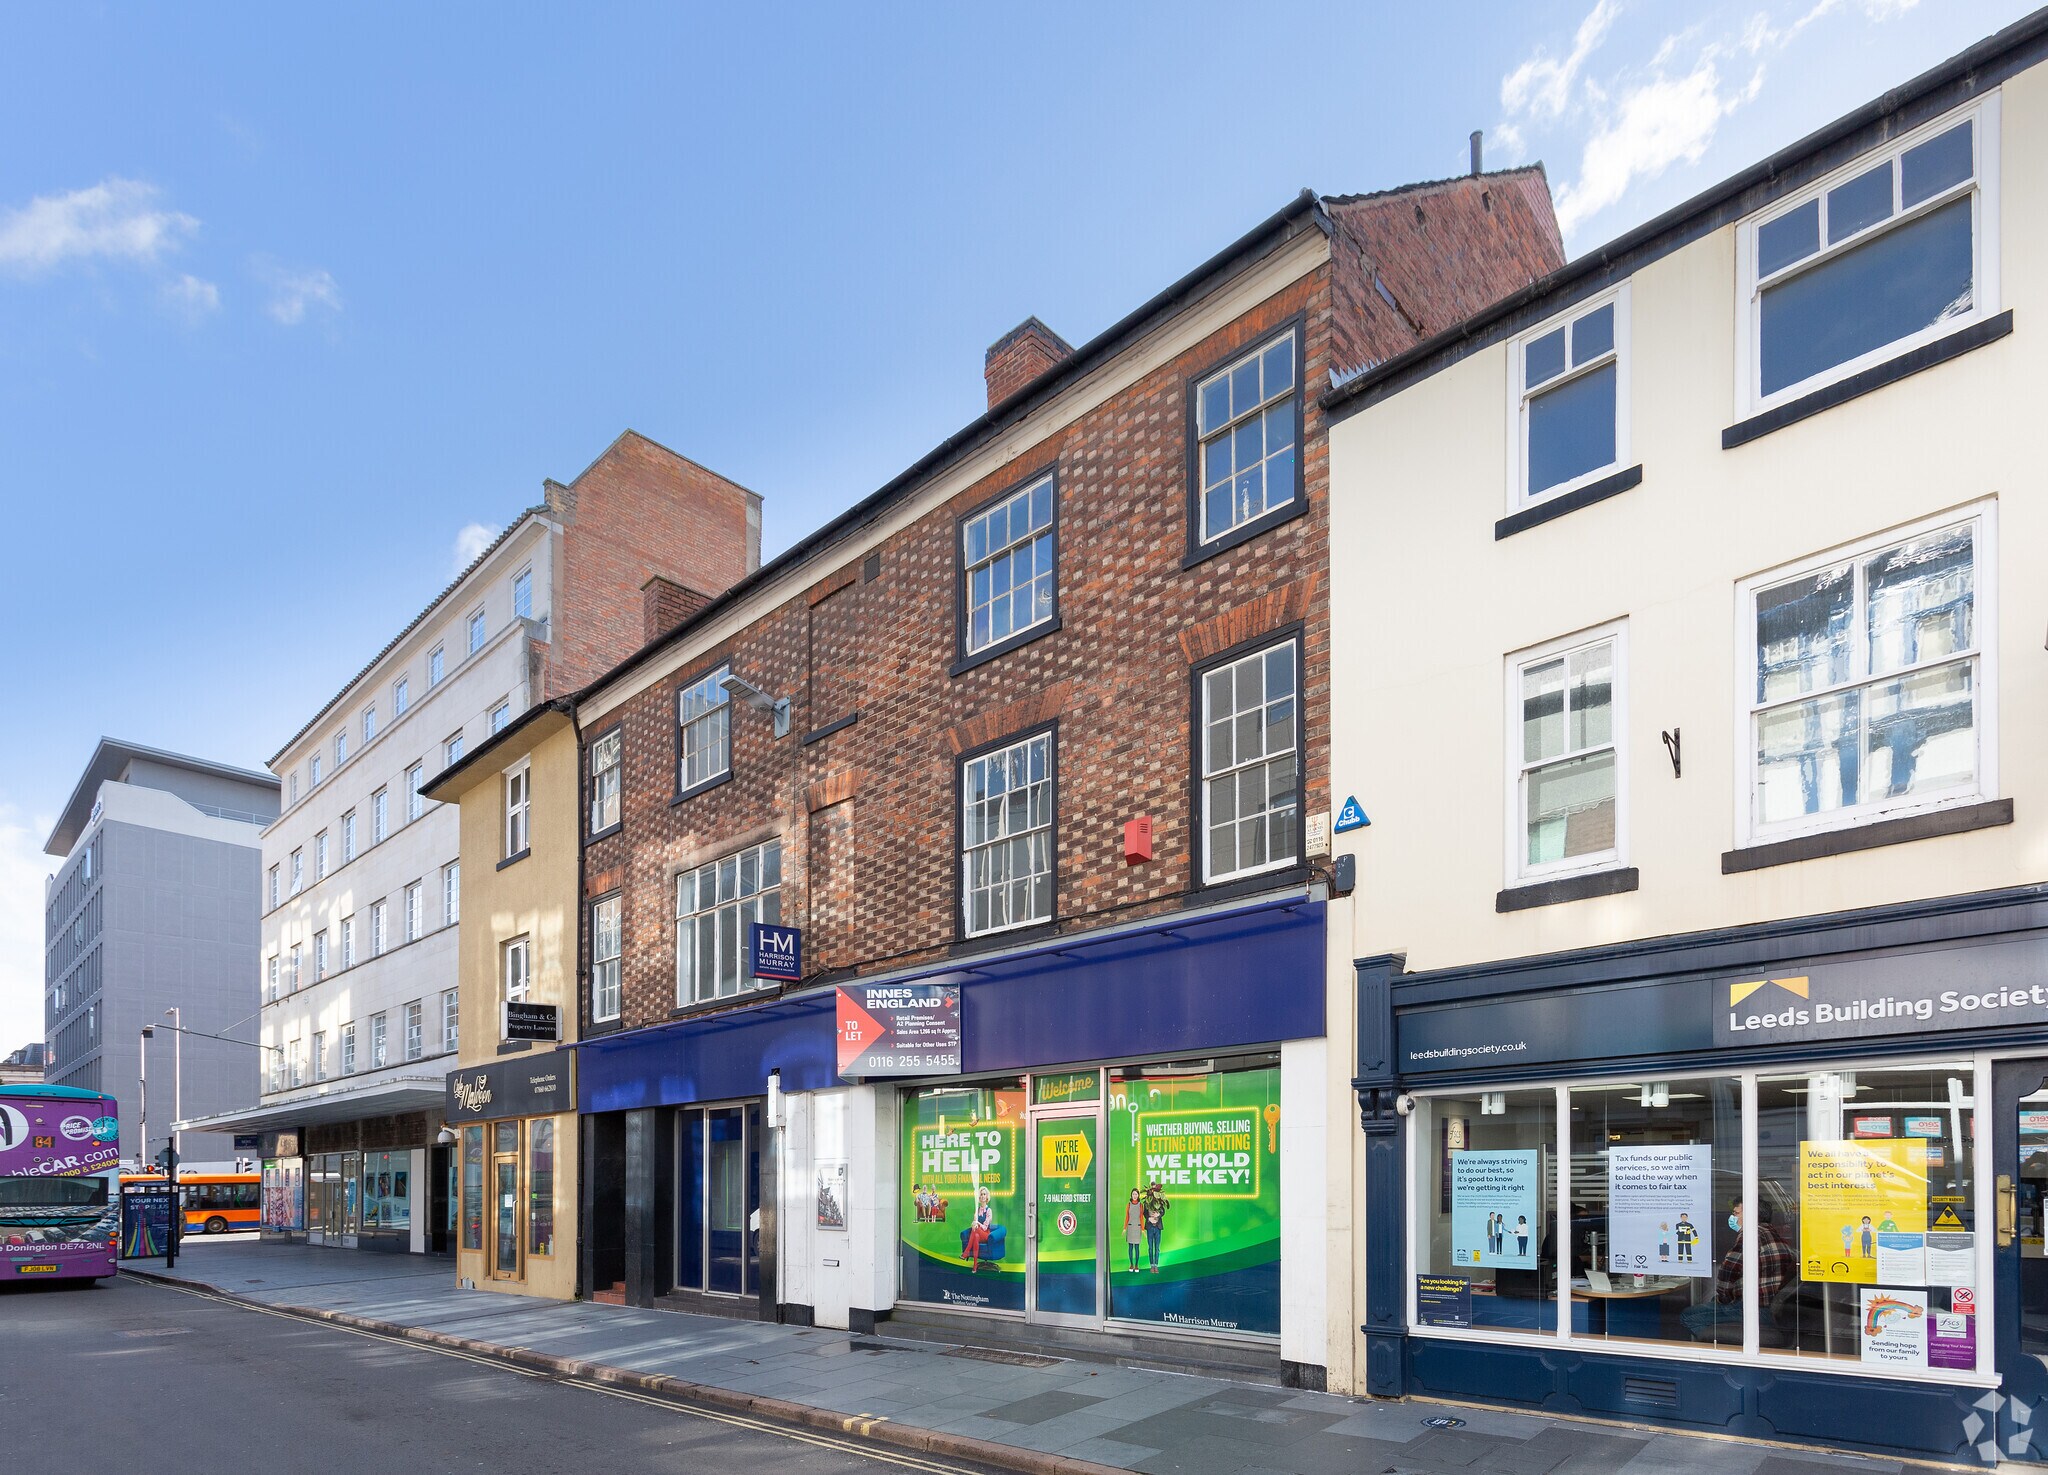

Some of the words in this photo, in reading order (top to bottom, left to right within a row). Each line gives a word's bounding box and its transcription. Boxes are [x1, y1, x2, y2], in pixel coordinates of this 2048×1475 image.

[1338, 816, 1360, 826] Chubb
[760, 930, 794, 954] HM
[759, 952, 794, 961] HARRISON
[759, 958, 794, 968] MURRAY
[867, 989, 912, 998] INNES
[867, 999, 941, 1008] ENGLAND
[1730, 1006, 1810, 1031] Leeds
[1815, 996, 1933, 1020] Building
[1940, 984, 2048, 1013] Societ
[508, 1011, 538, 1020] Bingham
[846, 1021, 858, 1030] TO
[846, 1032, 862, 1040] LET
[1410, 1041, 1527, 1060] leedsbuildingsociety.co.uk
[869, 1056, 893, 1067] 0116
[900, 1056, 920, 1066] 255
[1042, 1076, 1094, 1100] Welcome
[1146, 1123, 1182, 1136] WHETHER
[1184, 1121, 1215, 1134] BUYING,
[1216, 1120, 1250, 1133] SELLING
[35, 1136, 52, 1148] 84
[922, 1133, 970, 1149] HERE
[975, 1131, 1001, 1146] TO
[1146, 1136, 1185, 1152] LETTING
[1188, 1136, 1202, 1152] OR
[1205, 1134, 1250, 1151] RENTING
[1055, 1140, 1078, 1153] WE'RE
[922, 1149, 1001, 1172] HELP
[1146, 1154, 1181, 1168] WE
[1187, 1153, 1250, 1168] HOLD
[1669, 1154, 1692, 1162] public
[1056, 1155, 1078, 1172] NOW
[1808, 1161, 1873, 1169] responsibility
[922, 1174, 934, 1184] WITH
[935, 1174, 943, 1184] ALL
[944, 1174, 957, 1183] YOUR
[984, 1173, 1000, 1183] NEEDS
[1146, 1170, 1190, 1184] THE
[1197, 1169, 1250, 1184] KEY!
[1855, 1171, 1894, 1180] planet's
[1052, 1194, 1072, 1202] HALFORD
[1074, 1194, 1091, 1202] STREET
[6, 1244, 57, 1252] Donington
[960, 1294, 989, 1303] Nottingham
[1179, 1316, 1209, 1325] Harrison
[1211, 1319, 1237, 1330] Murray
[1872, 1340, 1898, 1348] Sending
[1899, 1348, 1920, 1356] family
